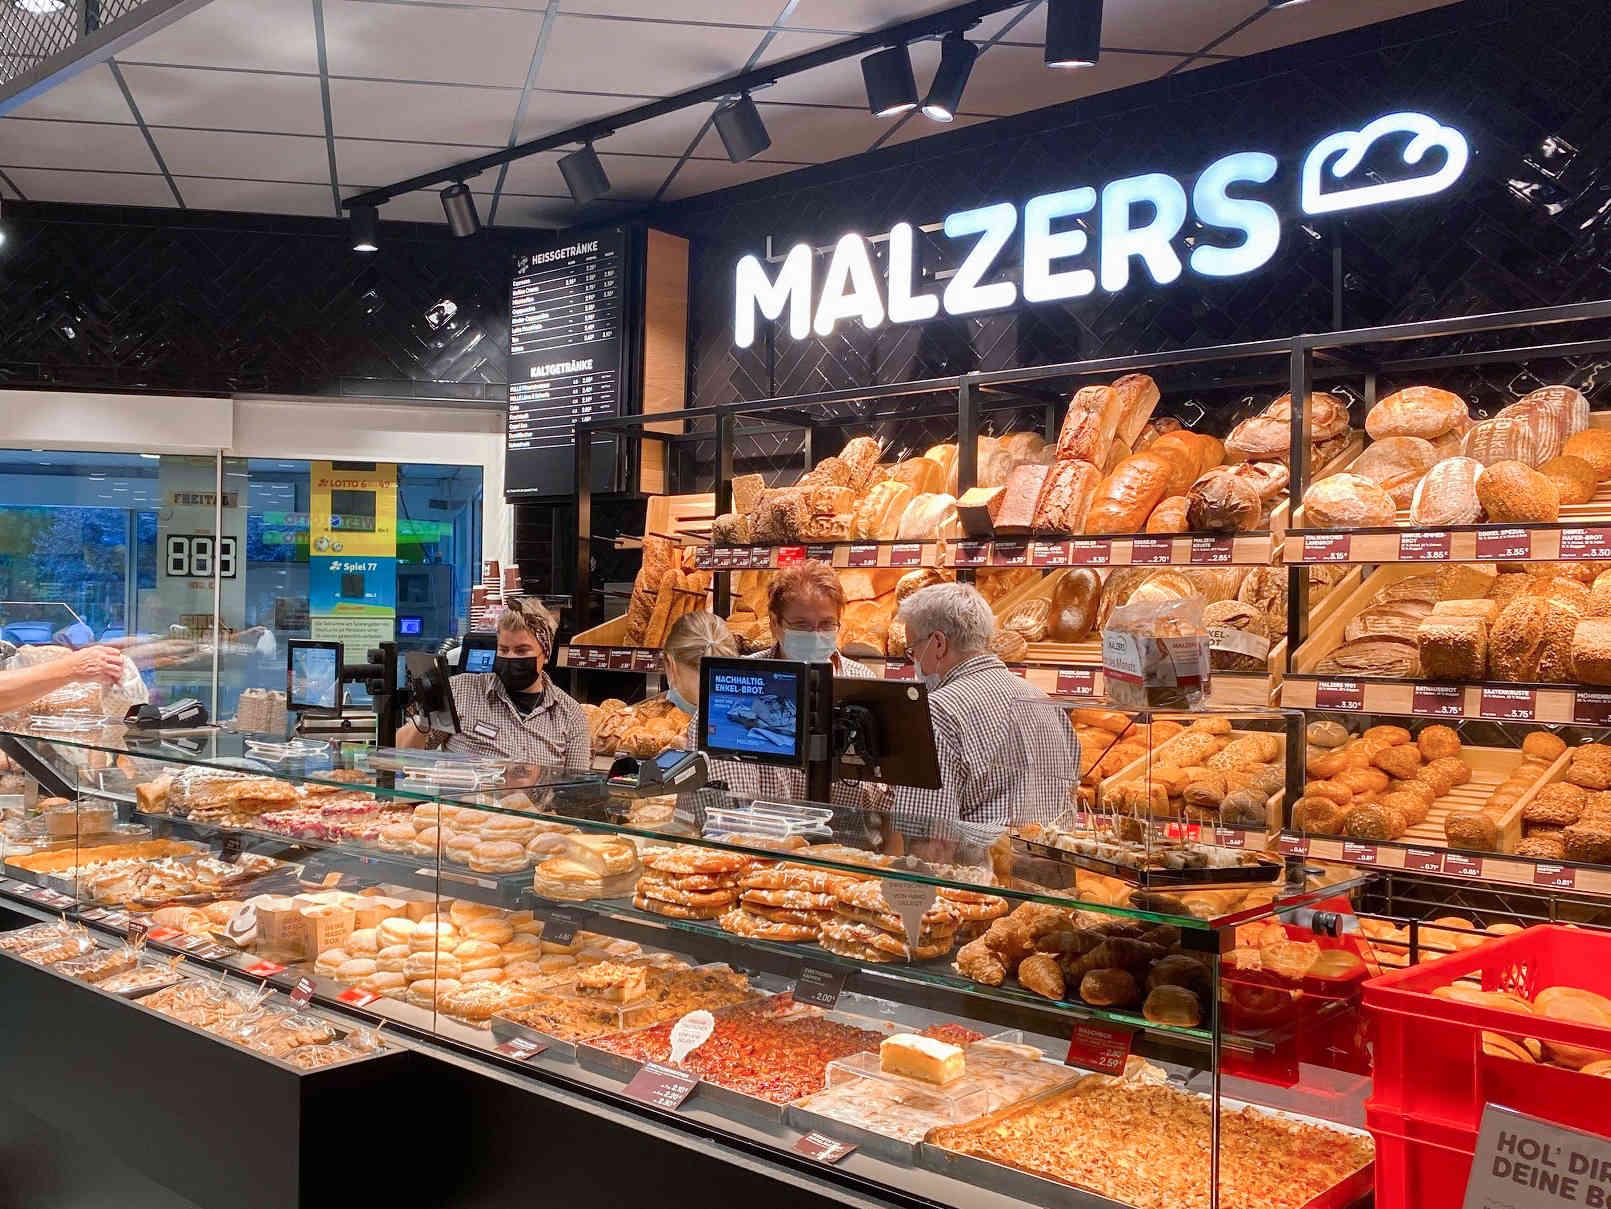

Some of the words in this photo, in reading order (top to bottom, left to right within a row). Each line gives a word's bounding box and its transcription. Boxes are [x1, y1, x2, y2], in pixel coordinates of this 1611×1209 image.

[532, 240, 599, 265] HEISSGETRÄNKE
[734, 150, 1281, 349] MALZERS
[530, 359, 594, 378] KALTGETRÄNKE
[330, 480, 359, 488] LOTTO
[343, 563, 366, 572] Spiel
[368, 563, 377, 571] 77
[715, 675, 766, 687] NACHHALTIG.
[715, 683, 765, 695] ENKEL-BROT.
[1497, 1131, 1562, 1168] HOL'
[1492, 1155, 1579, 1201] DEINE
